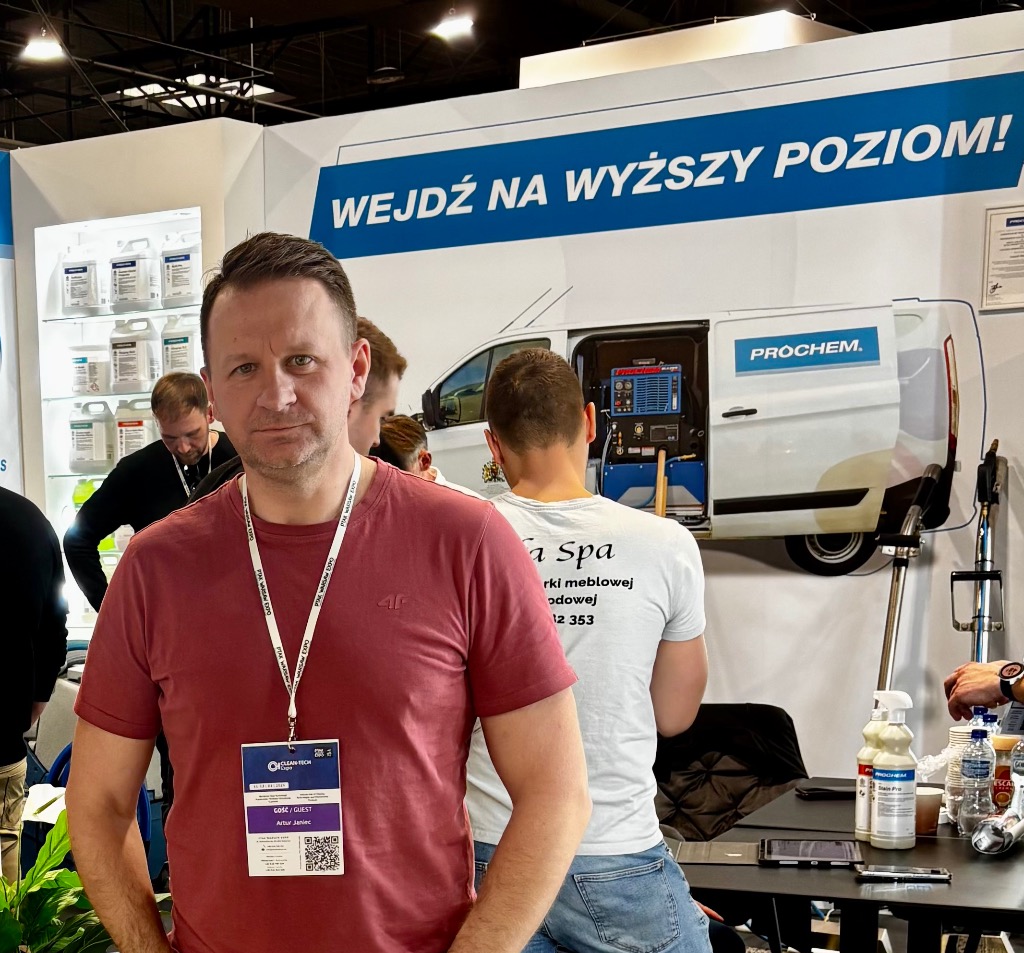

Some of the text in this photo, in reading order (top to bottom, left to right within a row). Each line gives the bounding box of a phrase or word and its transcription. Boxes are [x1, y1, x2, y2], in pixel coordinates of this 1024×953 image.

[331, 113, 1015, 229] WEJDŹ NA WYŻSZY POZIOM!
[555, 540, 616, 570] Spa
[325, 556, 334, 571] EXPO
[564, 576, 634, 590] meblowej
[263, 602, 272, 615] EXPO
[568, 614, 594, 626] 353
[301, 639, 309, 654] EXPO
